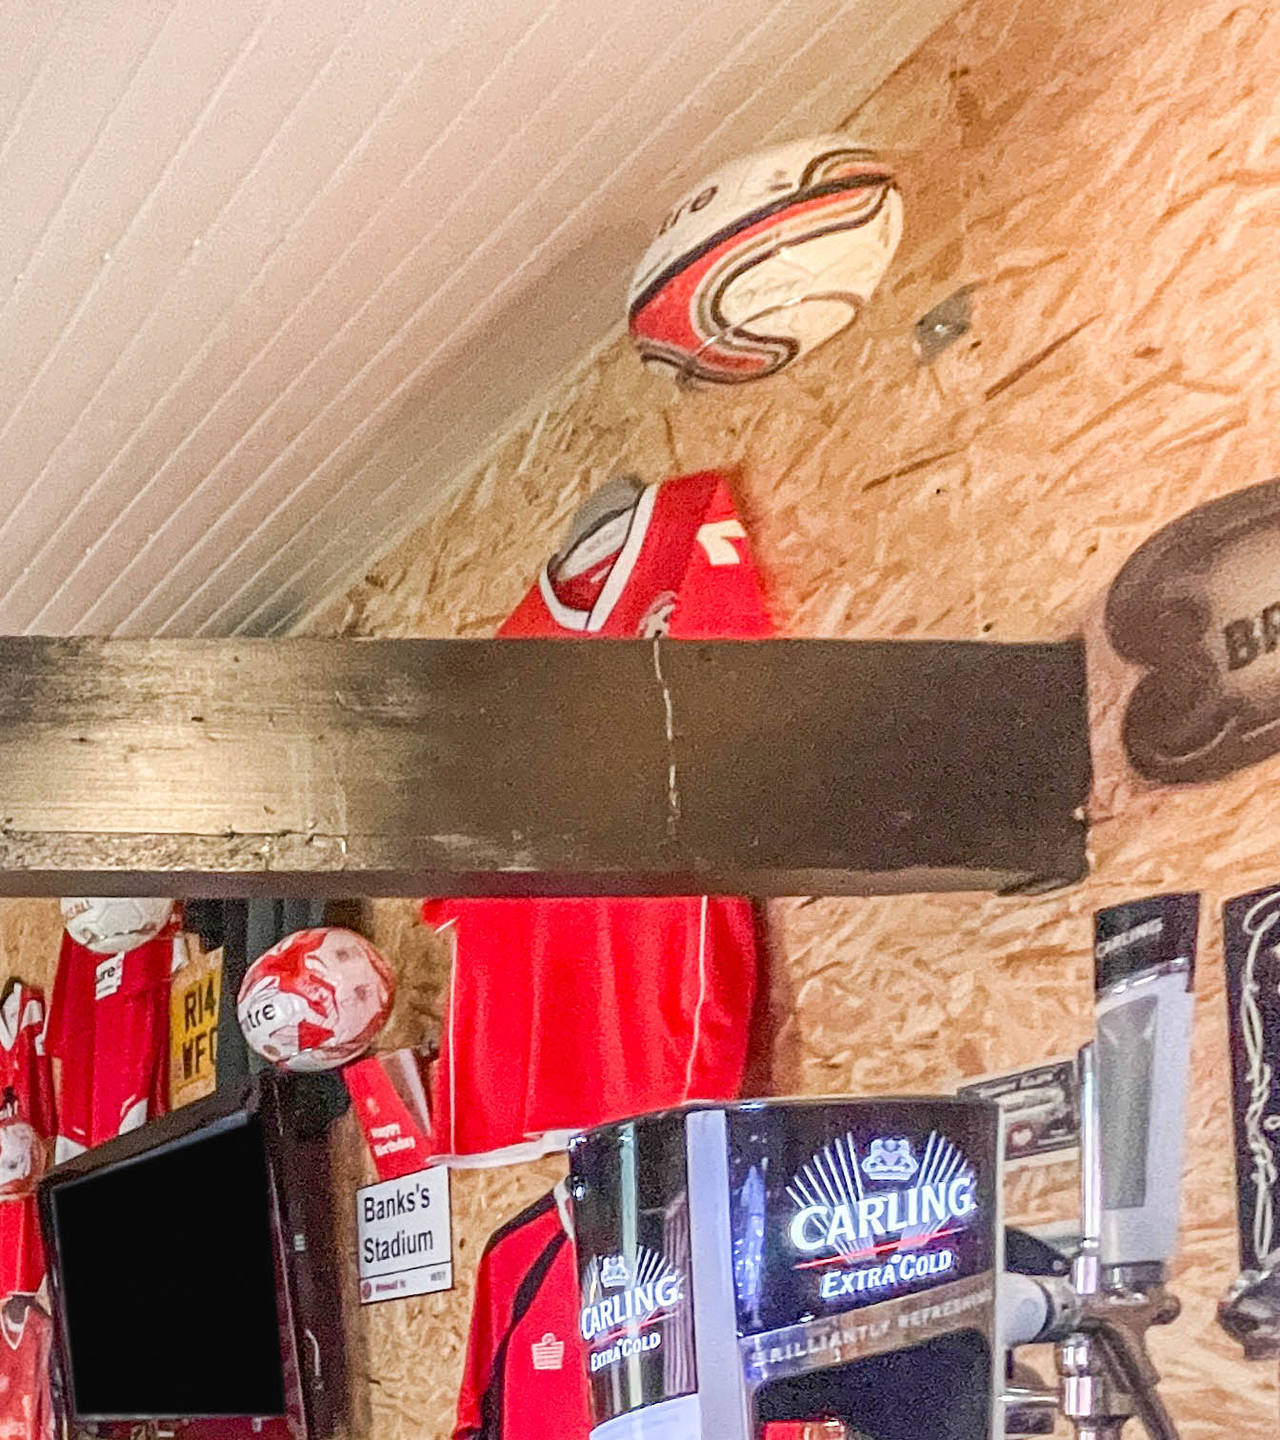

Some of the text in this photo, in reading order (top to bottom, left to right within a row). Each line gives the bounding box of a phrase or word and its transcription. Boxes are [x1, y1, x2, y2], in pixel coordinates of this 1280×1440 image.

[363, 1184, 431, 1223] Banks's
[790, 1178, 977, 1251] CARLING
[363, 1229, 434, 1263] Stadium
[581, 1275, 684, 1341] CARLING
